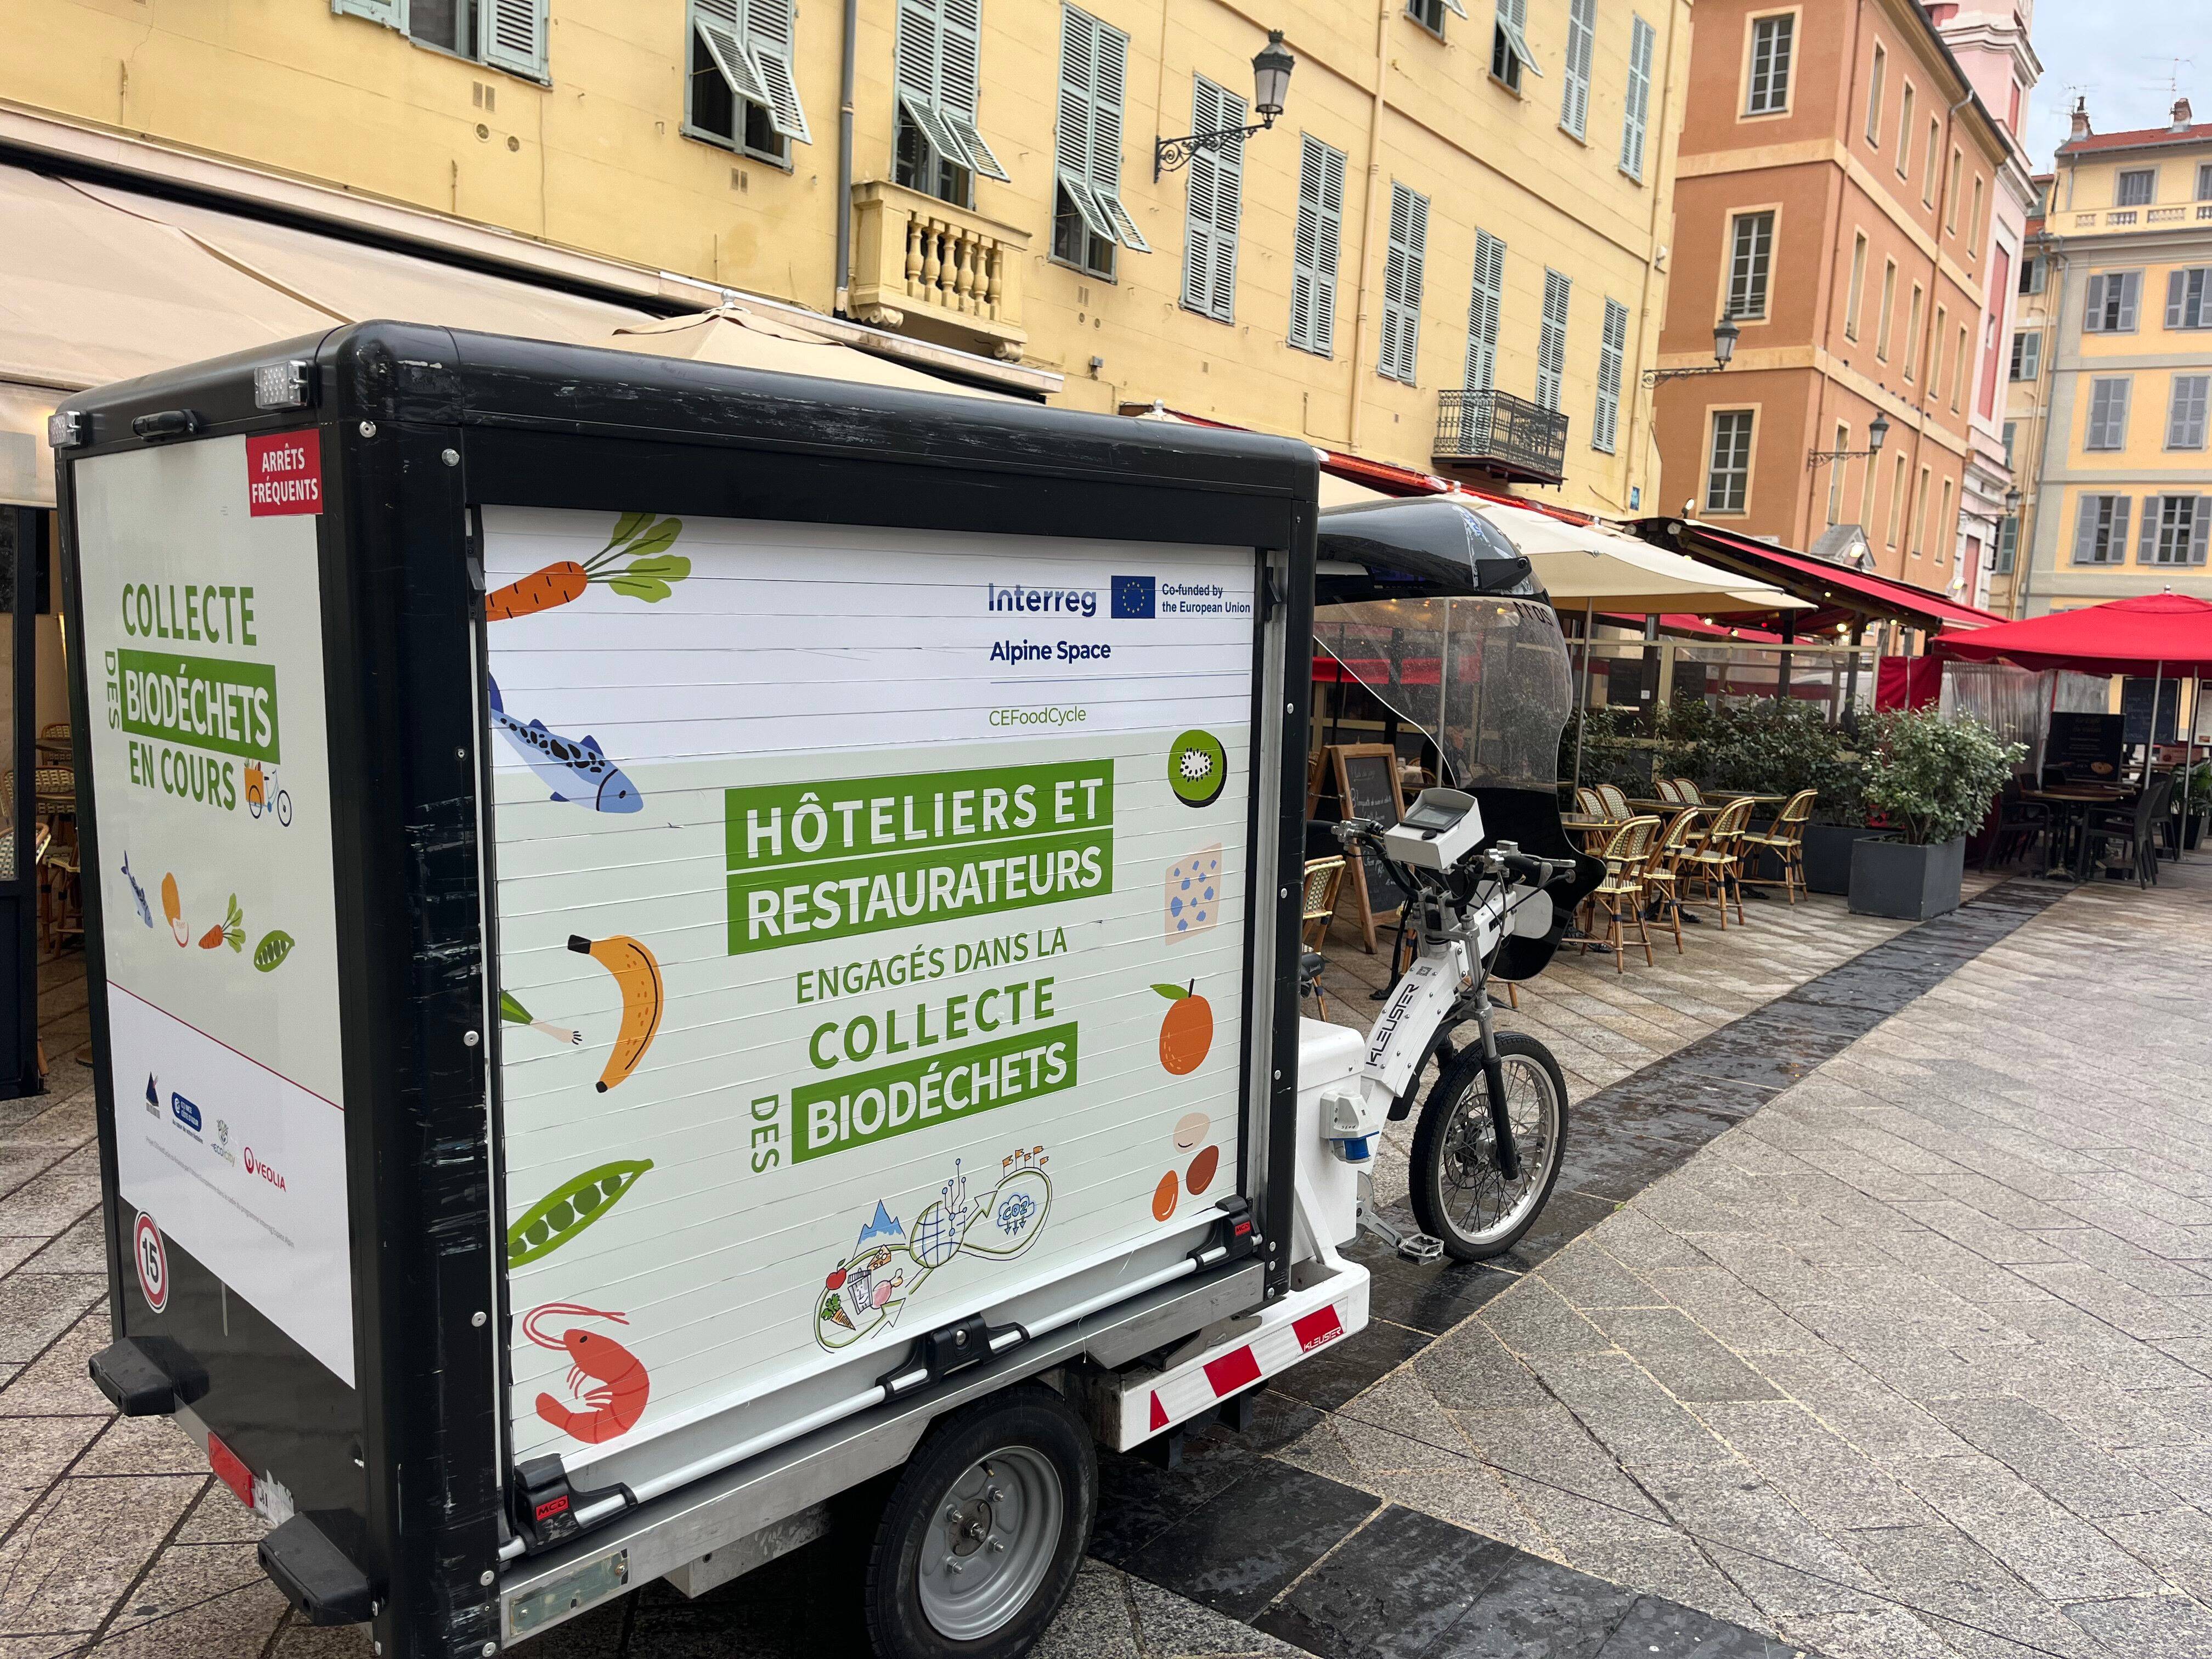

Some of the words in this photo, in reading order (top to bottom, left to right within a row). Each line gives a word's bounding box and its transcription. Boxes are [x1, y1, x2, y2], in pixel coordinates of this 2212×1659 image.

[262, 444, 305, 472] ARRÊTS
[252, 476, 319, 505] FRÉQUENTS
[989, 583, 1097, 617] Interreg
[1162, 583, 1210, 596] Co-funded
[1212, 585, 1223, 599] by
[1162, 601, 1177, 612] the
[1180, 601, 1222, 616] European
[1225, 601, 1250, 614] Union
[122, 583, 257, 646] COLLECTE
[990, 639, 1052, 665] Alpine
[1057, 640, 1111, 663] Space
[105, 651, 120, 730] DES
[126, 664, 272, 747] BIODÉCHETS
[989, 706, 1086, 726] CEFoodCycle
[129, 741, 154, 789] EN
[161, 748, 236, 811] COURS
[747, 784, 1037, 859] HÔTELIERS
[1054, 778, 1103, 824] ET
[747, 846, 1102, 940] RESTAURATEURS
[797, 944, 945, 1004] ENGAGÉS
[955, 932, 1029, 973] DANS
[1037, 926, 1068, 956] LA
[809, 977, 1054, 1070] COLLECTE
[1365, 984, 1420, 1066] KLEUSTER
[807, 1042, 1068, 1150] BIODÉCHETS
[751, 1094, 780, 1173] DES
[255, 1159, 286, 1192] VEOLIA
[1002, 1200, 1029, 1221] CO2
[142, 1238, 159, 1283] 15
[1304, 1327, 1341, 1352] KLEUSTER
[538, 1499, 567, 1516] MCD
